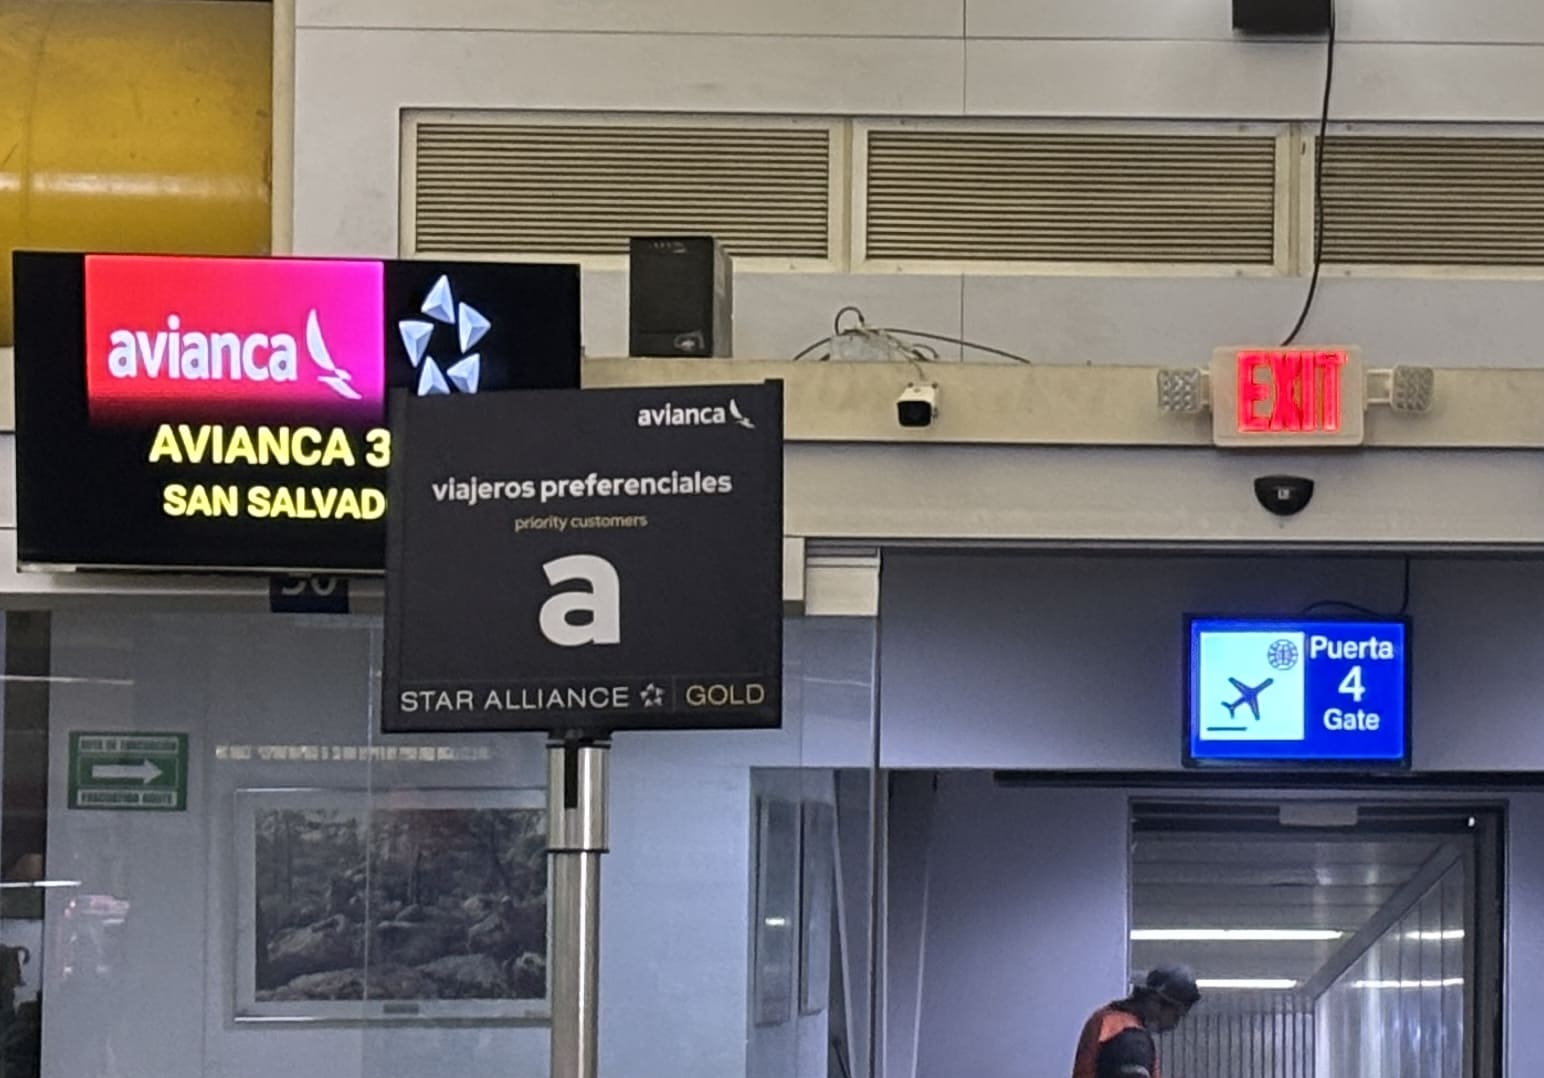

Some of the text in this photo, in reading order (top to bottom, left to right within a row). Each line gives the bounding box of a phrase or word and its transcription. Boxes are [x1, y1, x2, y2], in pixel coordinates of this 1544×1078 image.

[108, 314, 297, 382] avianca
[1237, 350, 1347, 433] EXIT
[637, 402, 726, 427] avianca
[148, 424, 355, 467] AVIANCA
[162, 484, 386, 519] SAN SALVAD
[432, 470, 732, 506] viajeros preferenciales
[515, 515, 648, 533] priority customers
[539, 554, 620, 647] a
[1310, 635, 1394, 660] Puerta
[400, 683, 764, 712] STAR ALLIANCE GOLD
[1338, 665, 1366, 703] 4
[1323, 708, 1380, 731] Gate
